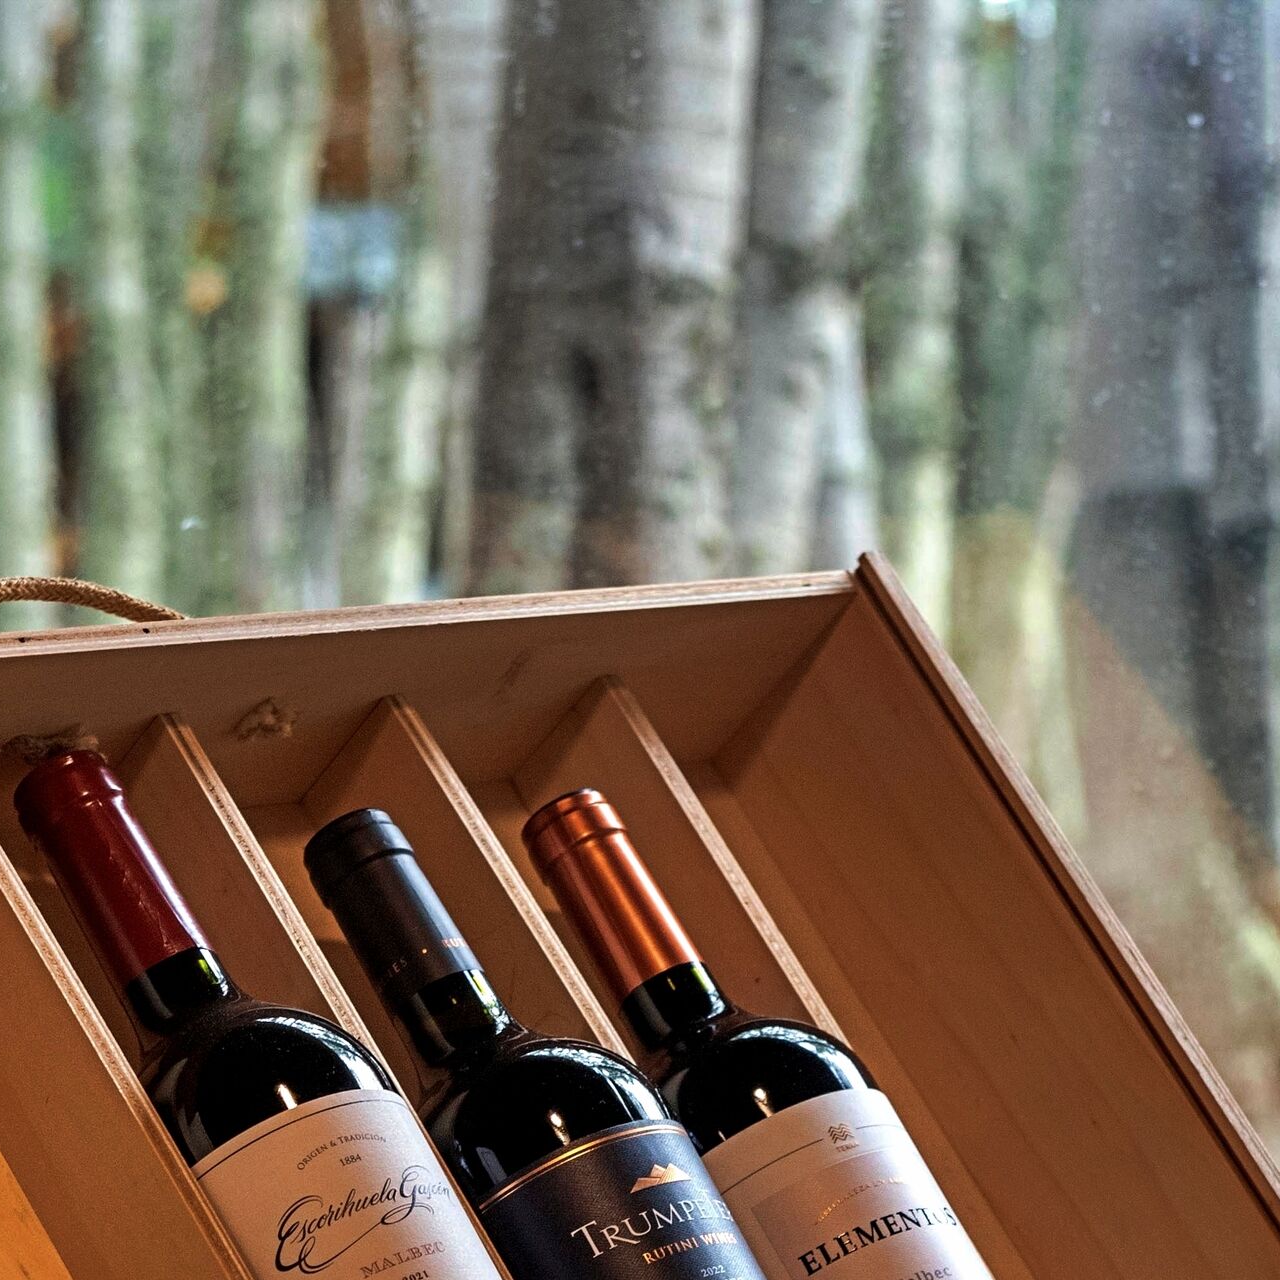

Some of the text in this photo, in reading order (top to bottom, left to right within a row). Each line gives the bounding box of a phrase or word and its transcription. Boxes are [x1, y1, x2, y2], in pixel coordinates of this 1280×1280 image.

[297, 1144, 327, 1171] ORIGEN
[330, 1140, 337, 1148] &
[340, 1153, 362, 1167] 1884
[275, 1177, 397, 1273] Escorihuela
[642, 1237, 700, 1265] RUTINI
[797, 1207, 958, 1277] ELEMENTOS
[360, 1241, 447, 1279] MALBEC
[701, 1265, 726, 1278] 2022
